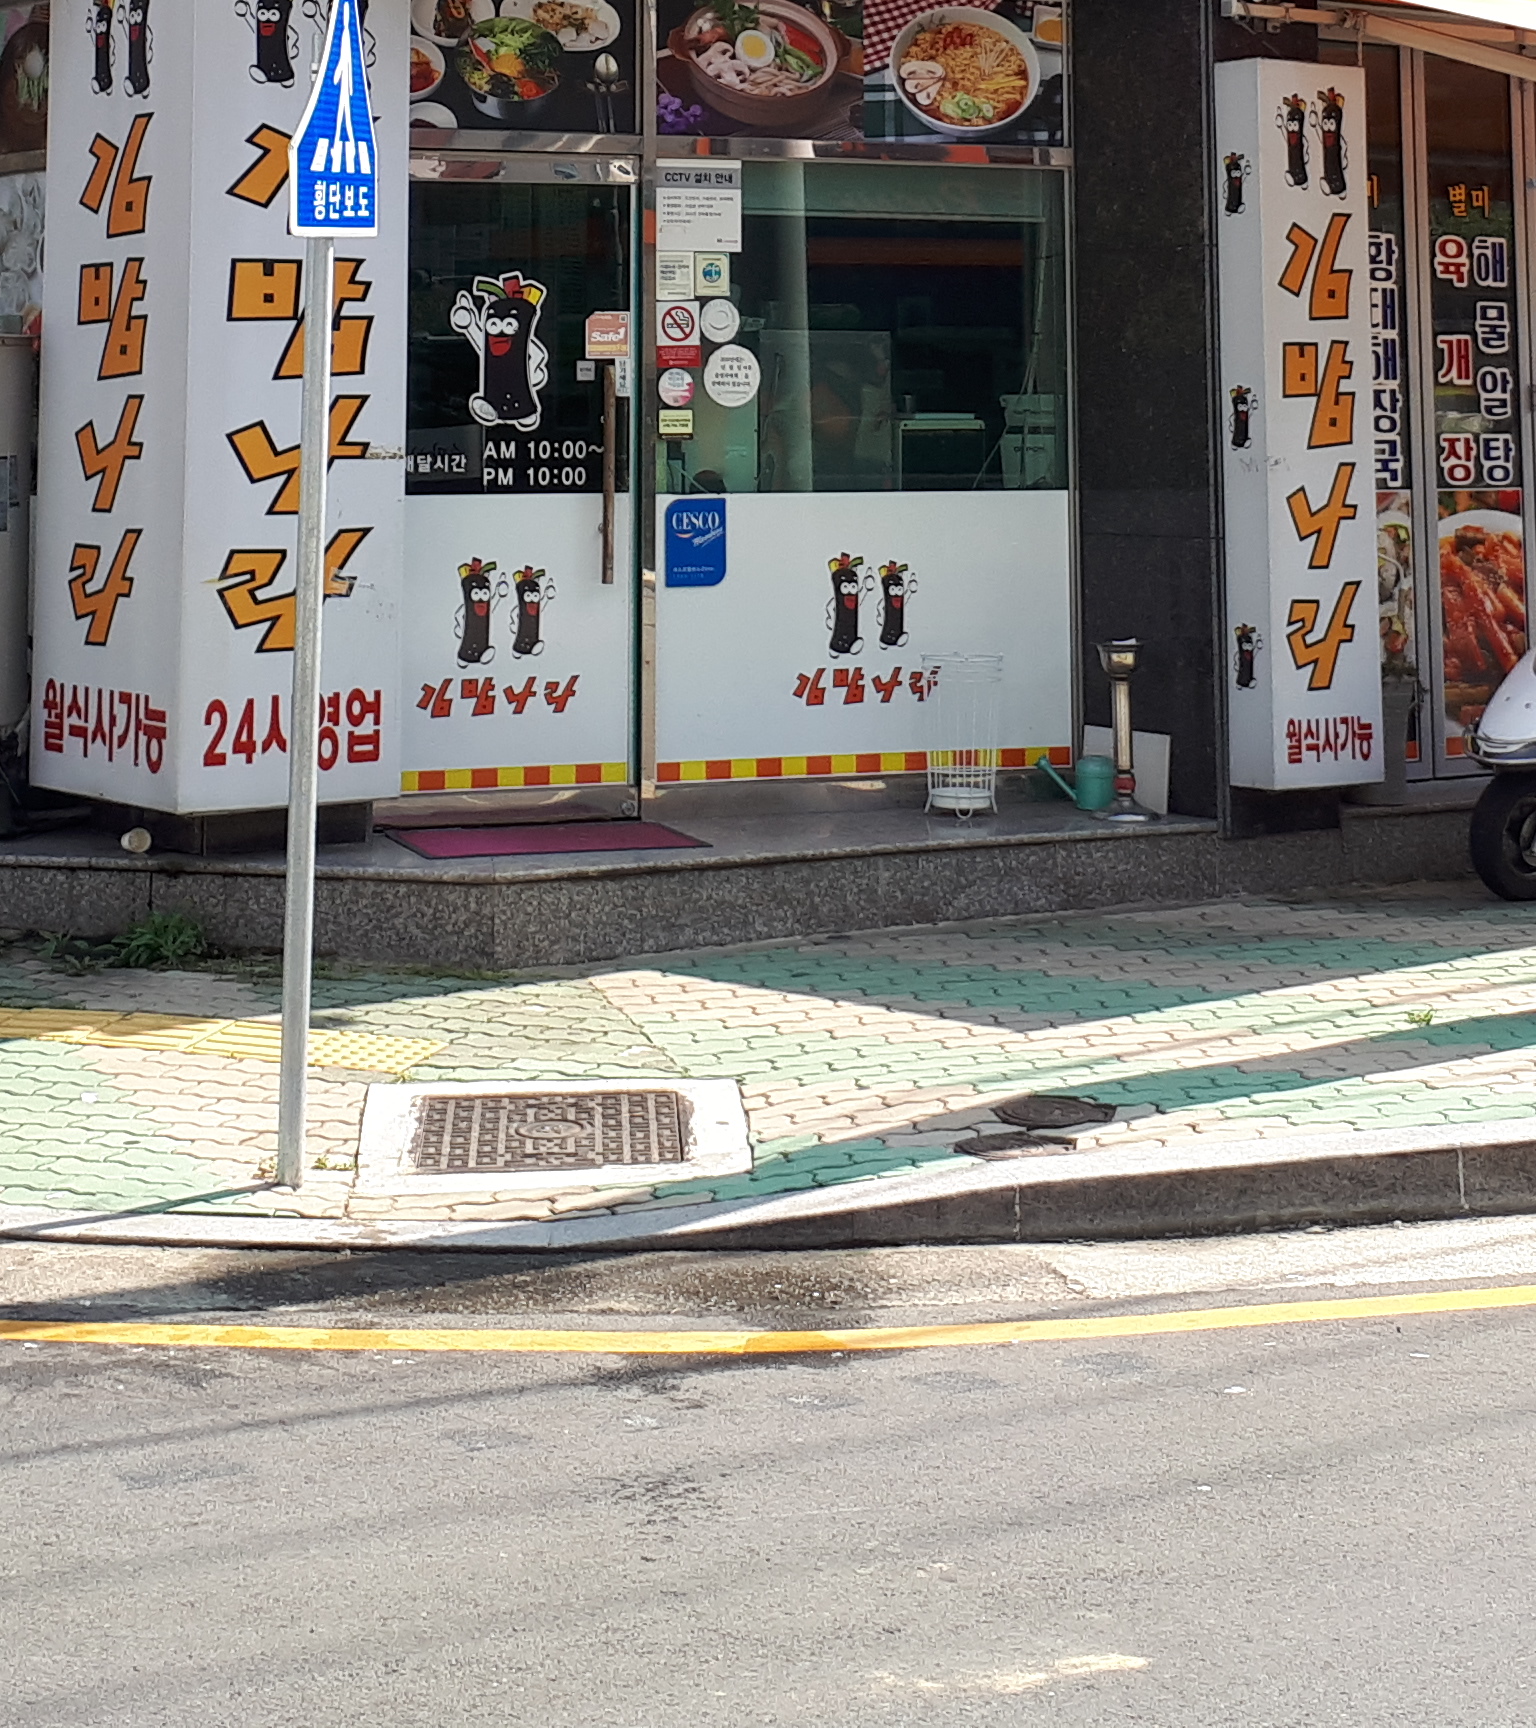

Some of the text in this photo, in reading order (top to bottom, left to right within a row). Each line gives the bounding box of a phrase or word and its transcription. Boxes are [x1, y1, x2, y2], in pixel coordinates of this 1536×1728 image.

[664, 172, 733, 184] CCTV 설치 안내
[312, 179, 370, 221] 횡단보도
[1446, 182, 1490, 218] 별미
[482, 440, 516, 460] AM
[482, 467, 586, 486] PM 10:00
[672, 511, 720, 530] CESCO
[42, 677, 168, 775] 월식사가능
[1285, 715, 1374, 765] 월식사가능
